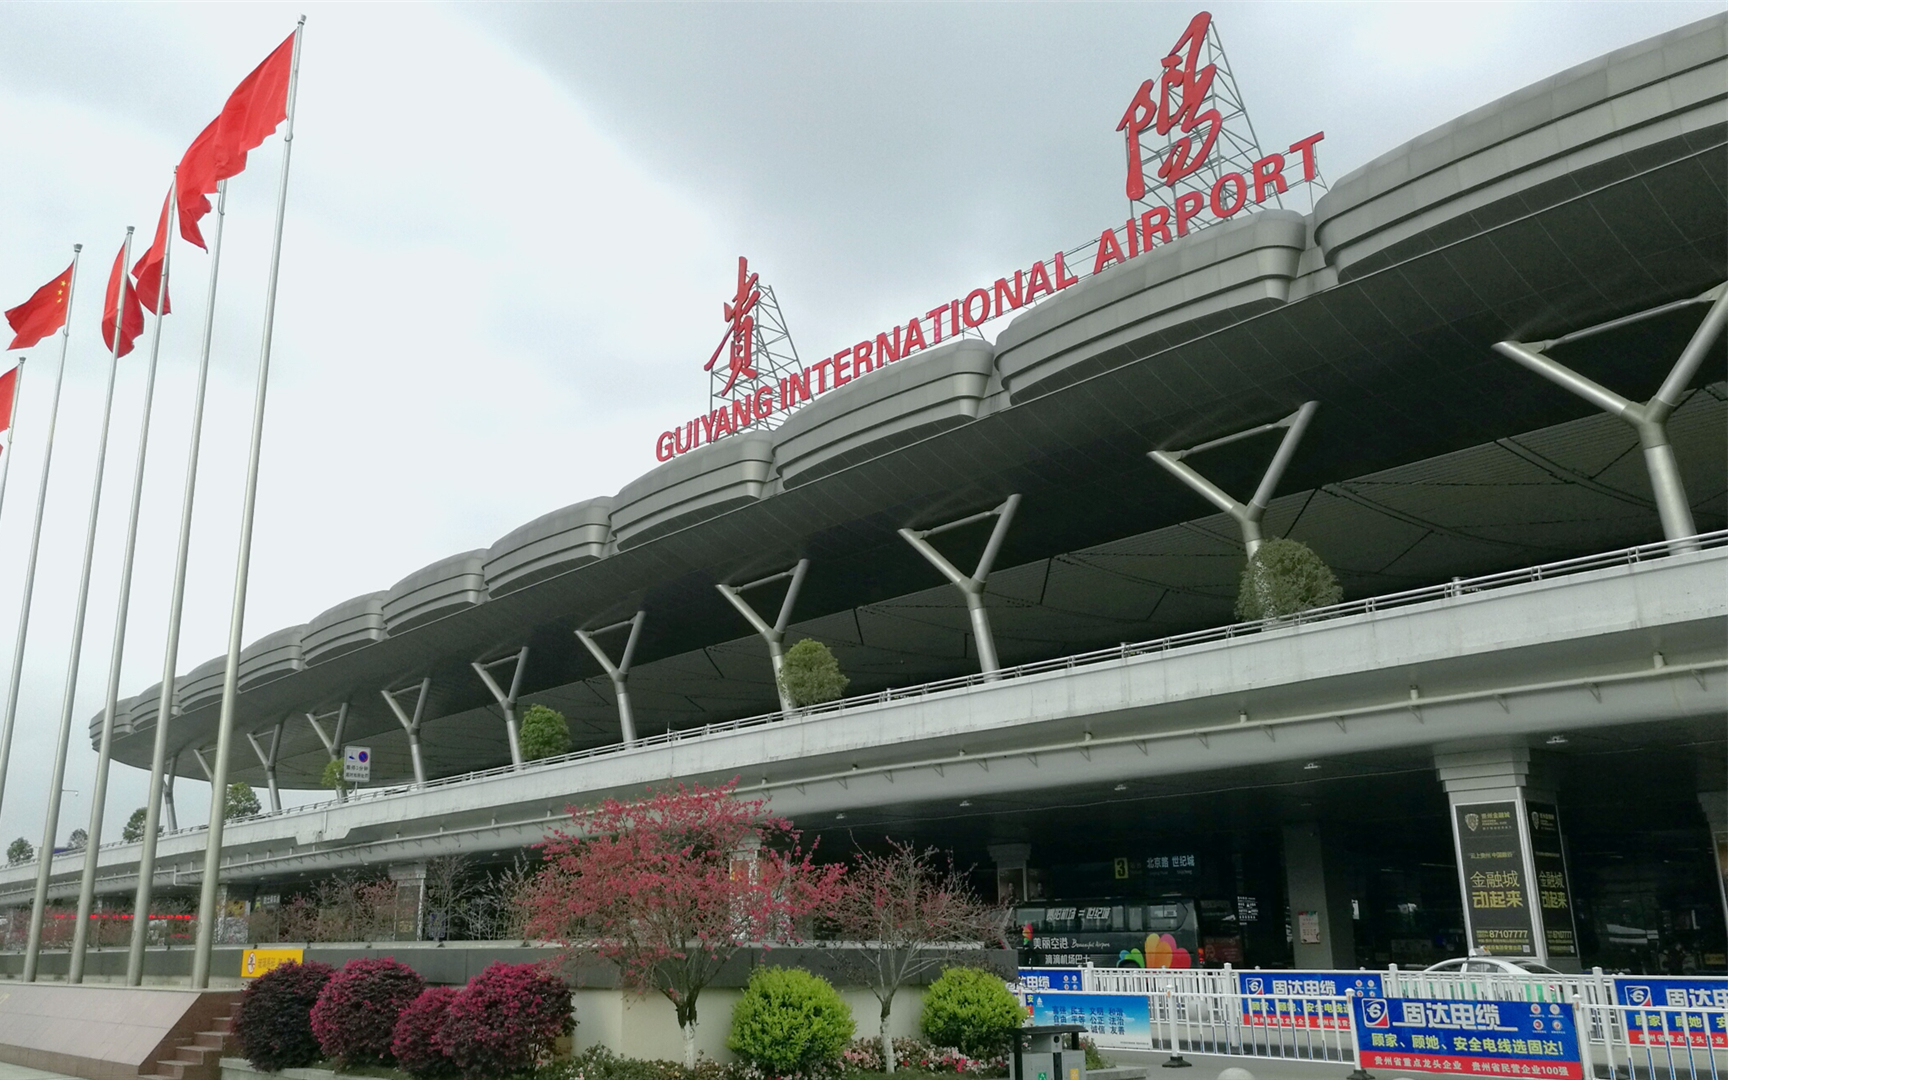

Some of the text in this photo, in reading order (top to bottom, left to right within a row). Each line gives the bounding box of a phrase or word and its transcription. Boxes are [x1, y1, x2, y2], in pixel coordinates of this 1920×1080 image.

[656, 131, 1325, 462] GUIYANG INTERNATIONAL AIRPORT
[1116, 859, 1126, 877] 3
[1146, 855, 1195, 868] 北京路 世纪城
[1470, 870, 1520, 888] 金融城
[1472, 890, 1524, 908] 动起来
[1489, 930, 1528, 938] 87107777
[1033, 936, 1069, 950] 美丽空港
[1045, 953, 1091, 965] 滴滴机场巴士
[1272, 980, 1336, 996] 固达电缆
[1090, 1016, 1105, 1025] 公正
[1109, 1017, 1124, 1025] 法治
[1402, 1002, 1502, 1031] 固达电缆
[1110, 1026, 1125, 1035] 友善
[1371, 1033, 1564, 1056] 顾家、顾她、安全电线选固达!
[1374, 1055, 1570, 1077] 贵州省重点龙头企业 贵州省民营企业100强
